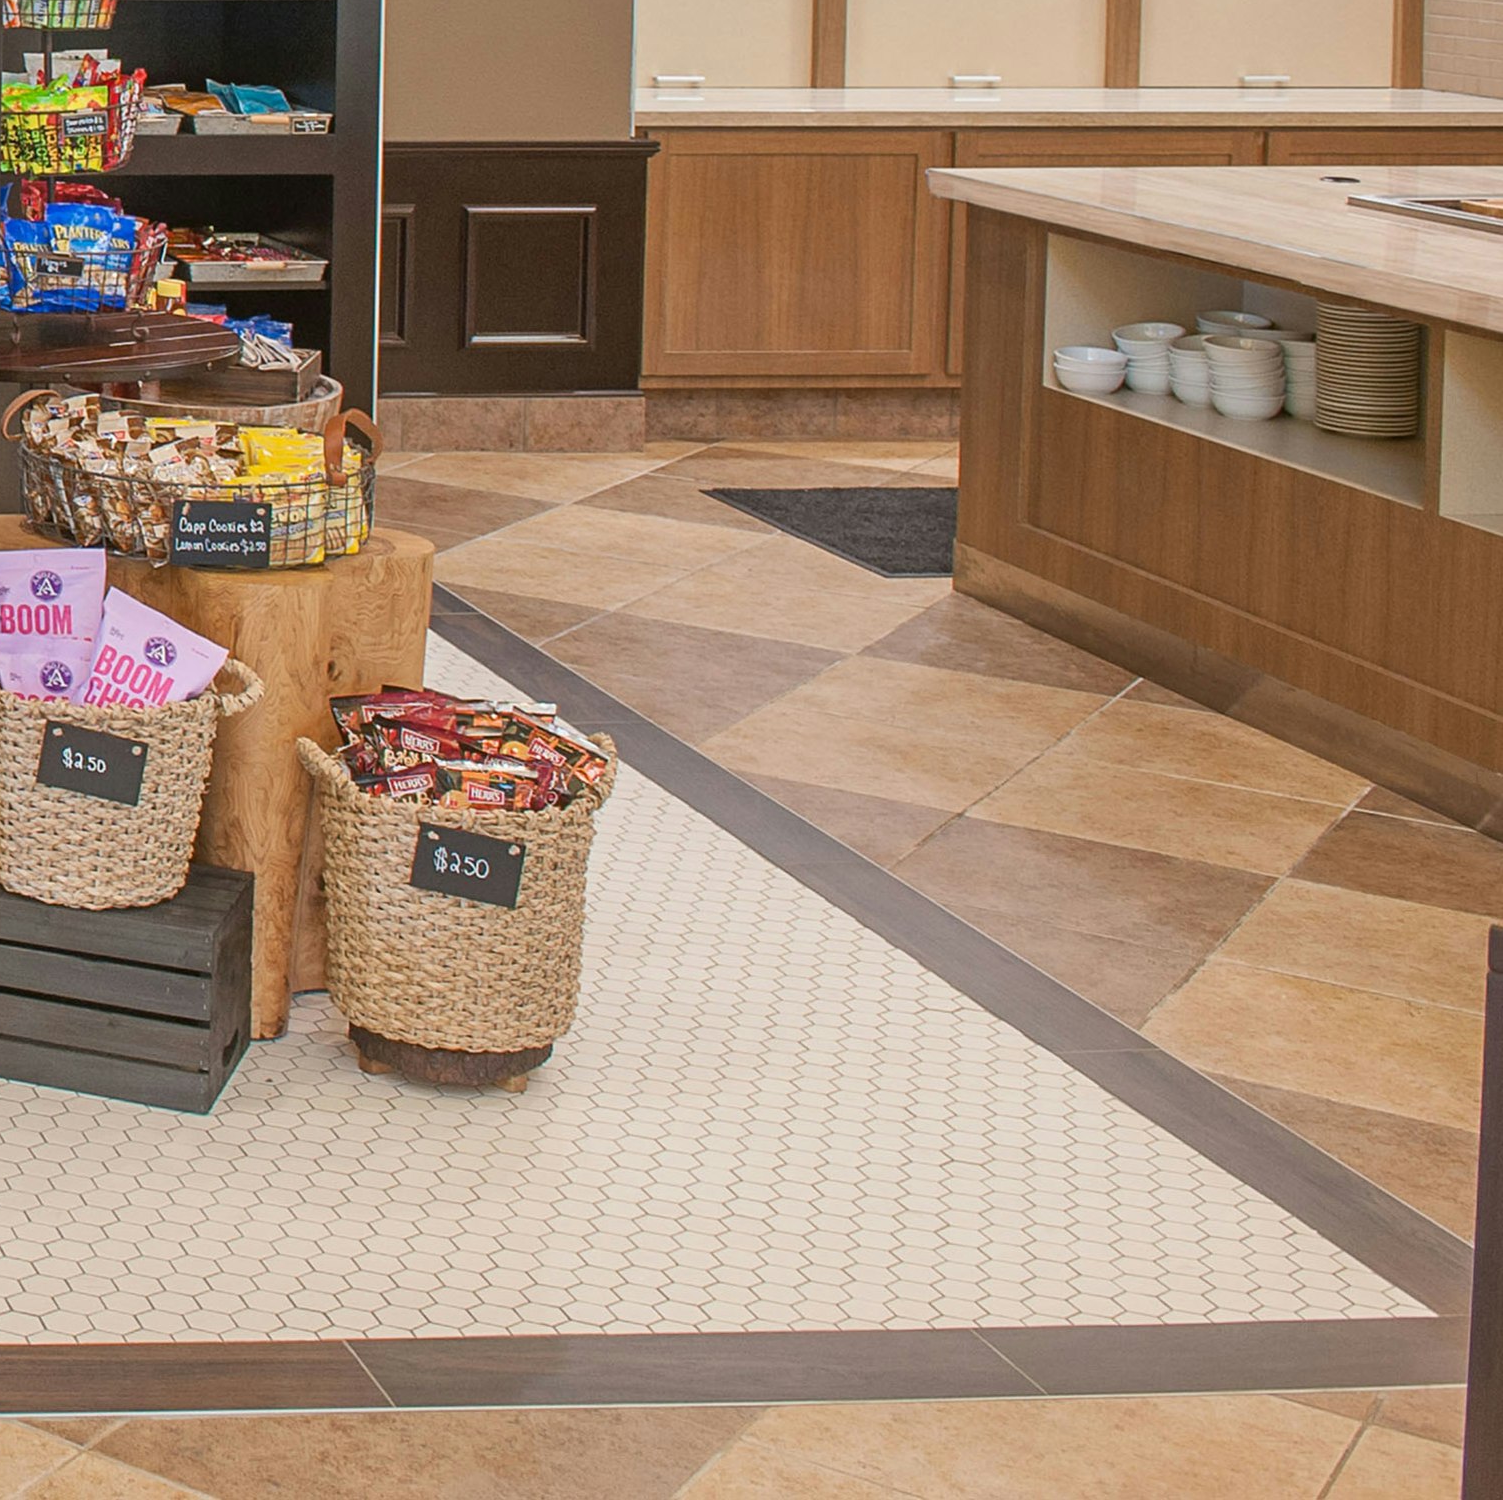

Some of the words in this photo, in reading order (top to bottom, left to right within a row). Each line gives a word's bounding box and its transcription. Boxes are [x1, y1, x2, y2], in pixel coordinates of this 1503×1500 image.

[179, 517, 206, 537] Capp
[208, 518, 248, 534] Cookies
[250, 518, 265, 535] $2
[204, 538, 241, 553] Cookies
[0, 603, 72, 636] BOOM
[93, 643, 175, 707] BOOM
[432, 846, 490, 880] $2.50
